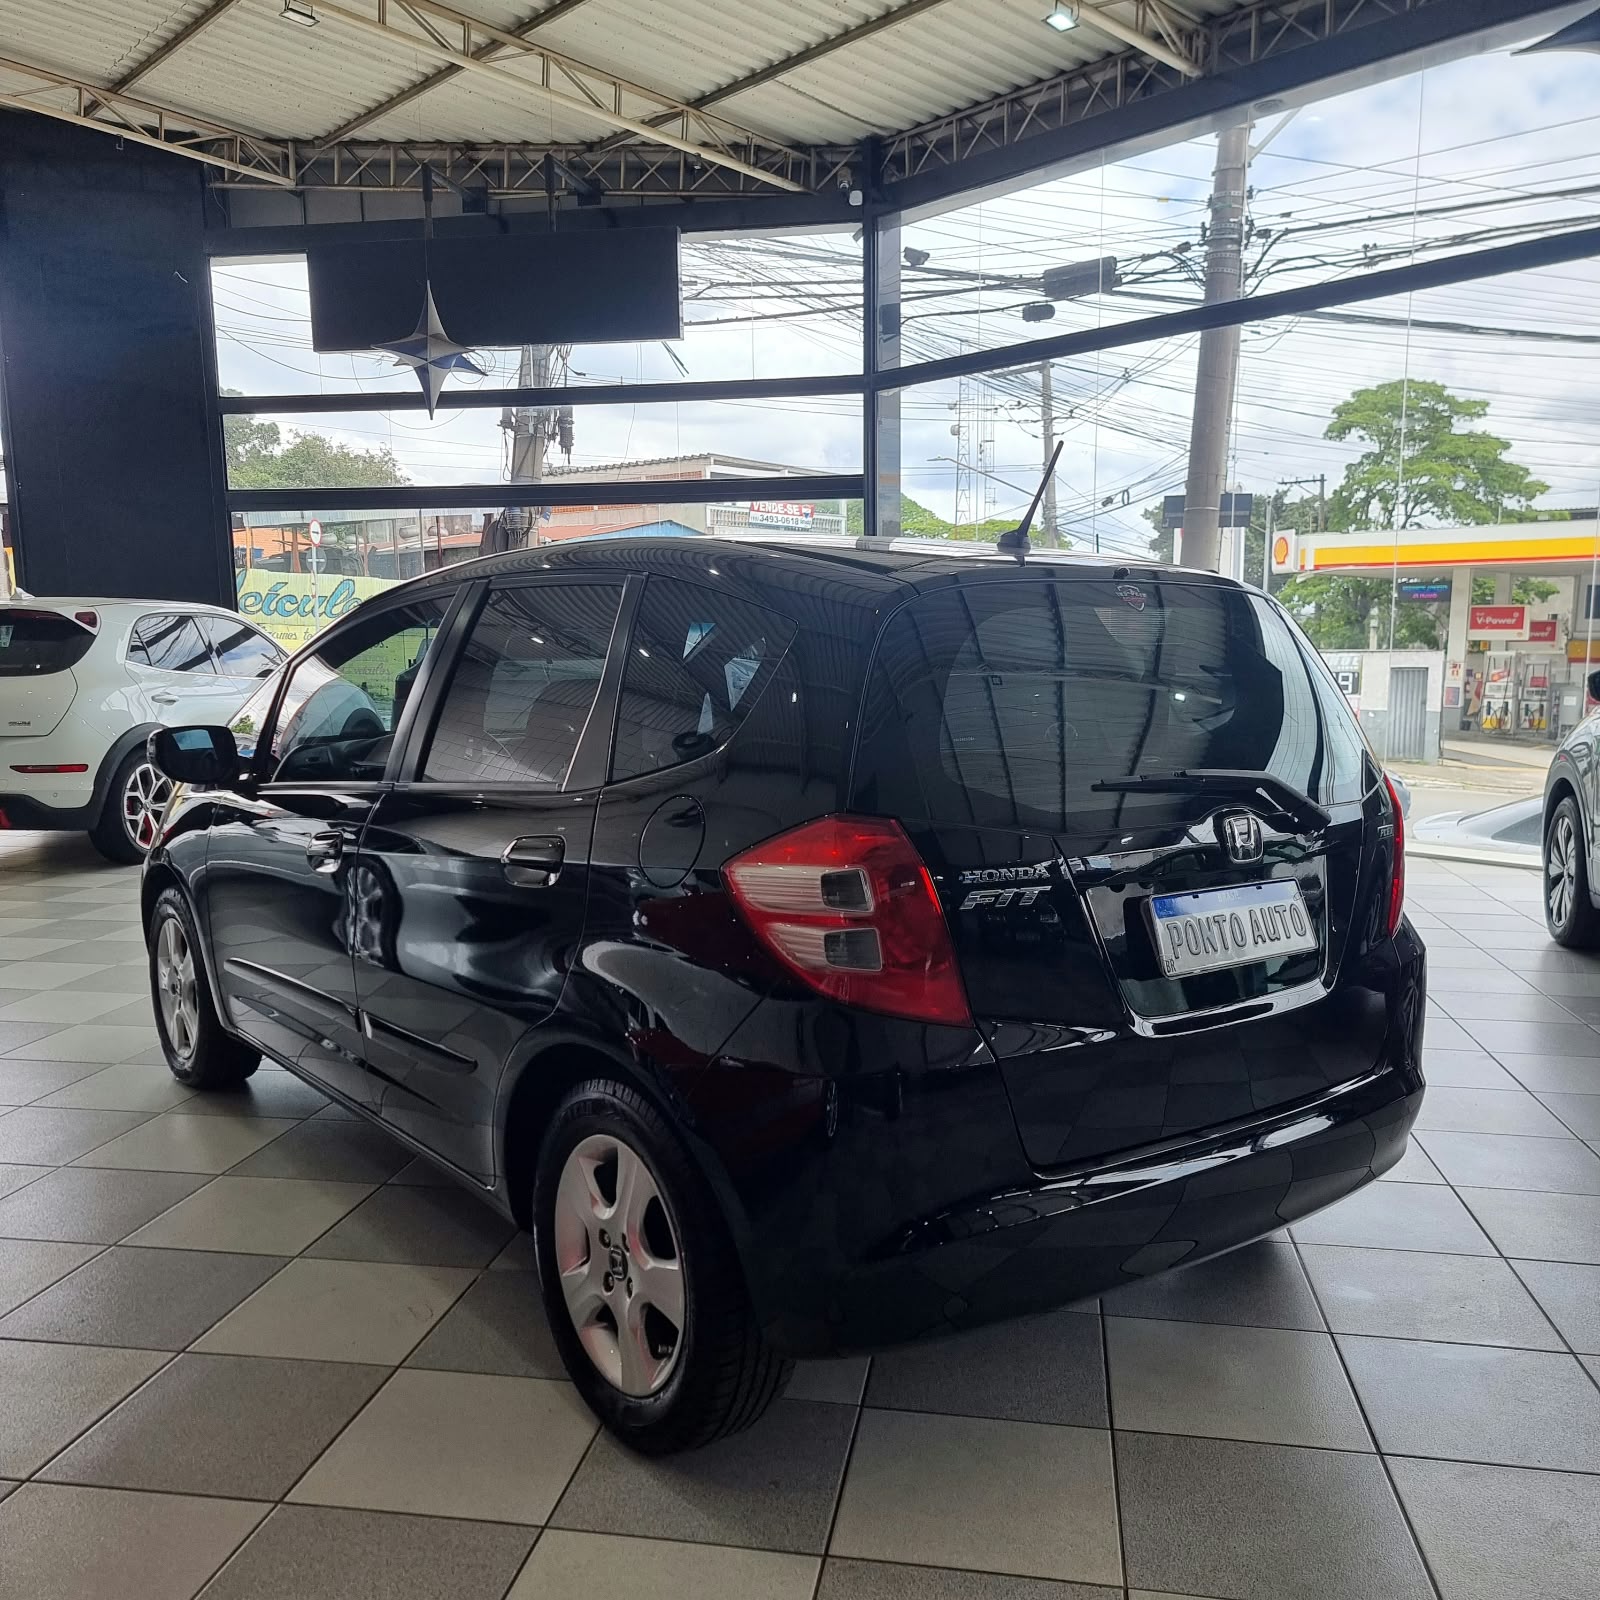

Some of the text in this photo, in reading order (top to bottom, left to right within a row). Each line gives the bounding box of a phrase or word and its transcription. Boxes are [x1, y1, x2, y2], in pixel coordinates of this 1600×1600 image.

[752, 501, 800, 515] VENDE-SE
[760, 514, 799, 525] 3493-0618
[1476, 616, 1517, 625] V-Power
[962, 866, 1051, 884] HONDA
[959, 886, 1052, 909] FIT
[1166, 903, 1307, 960] PONTO AUTO
[1165, 959, 1177, 973] BR
